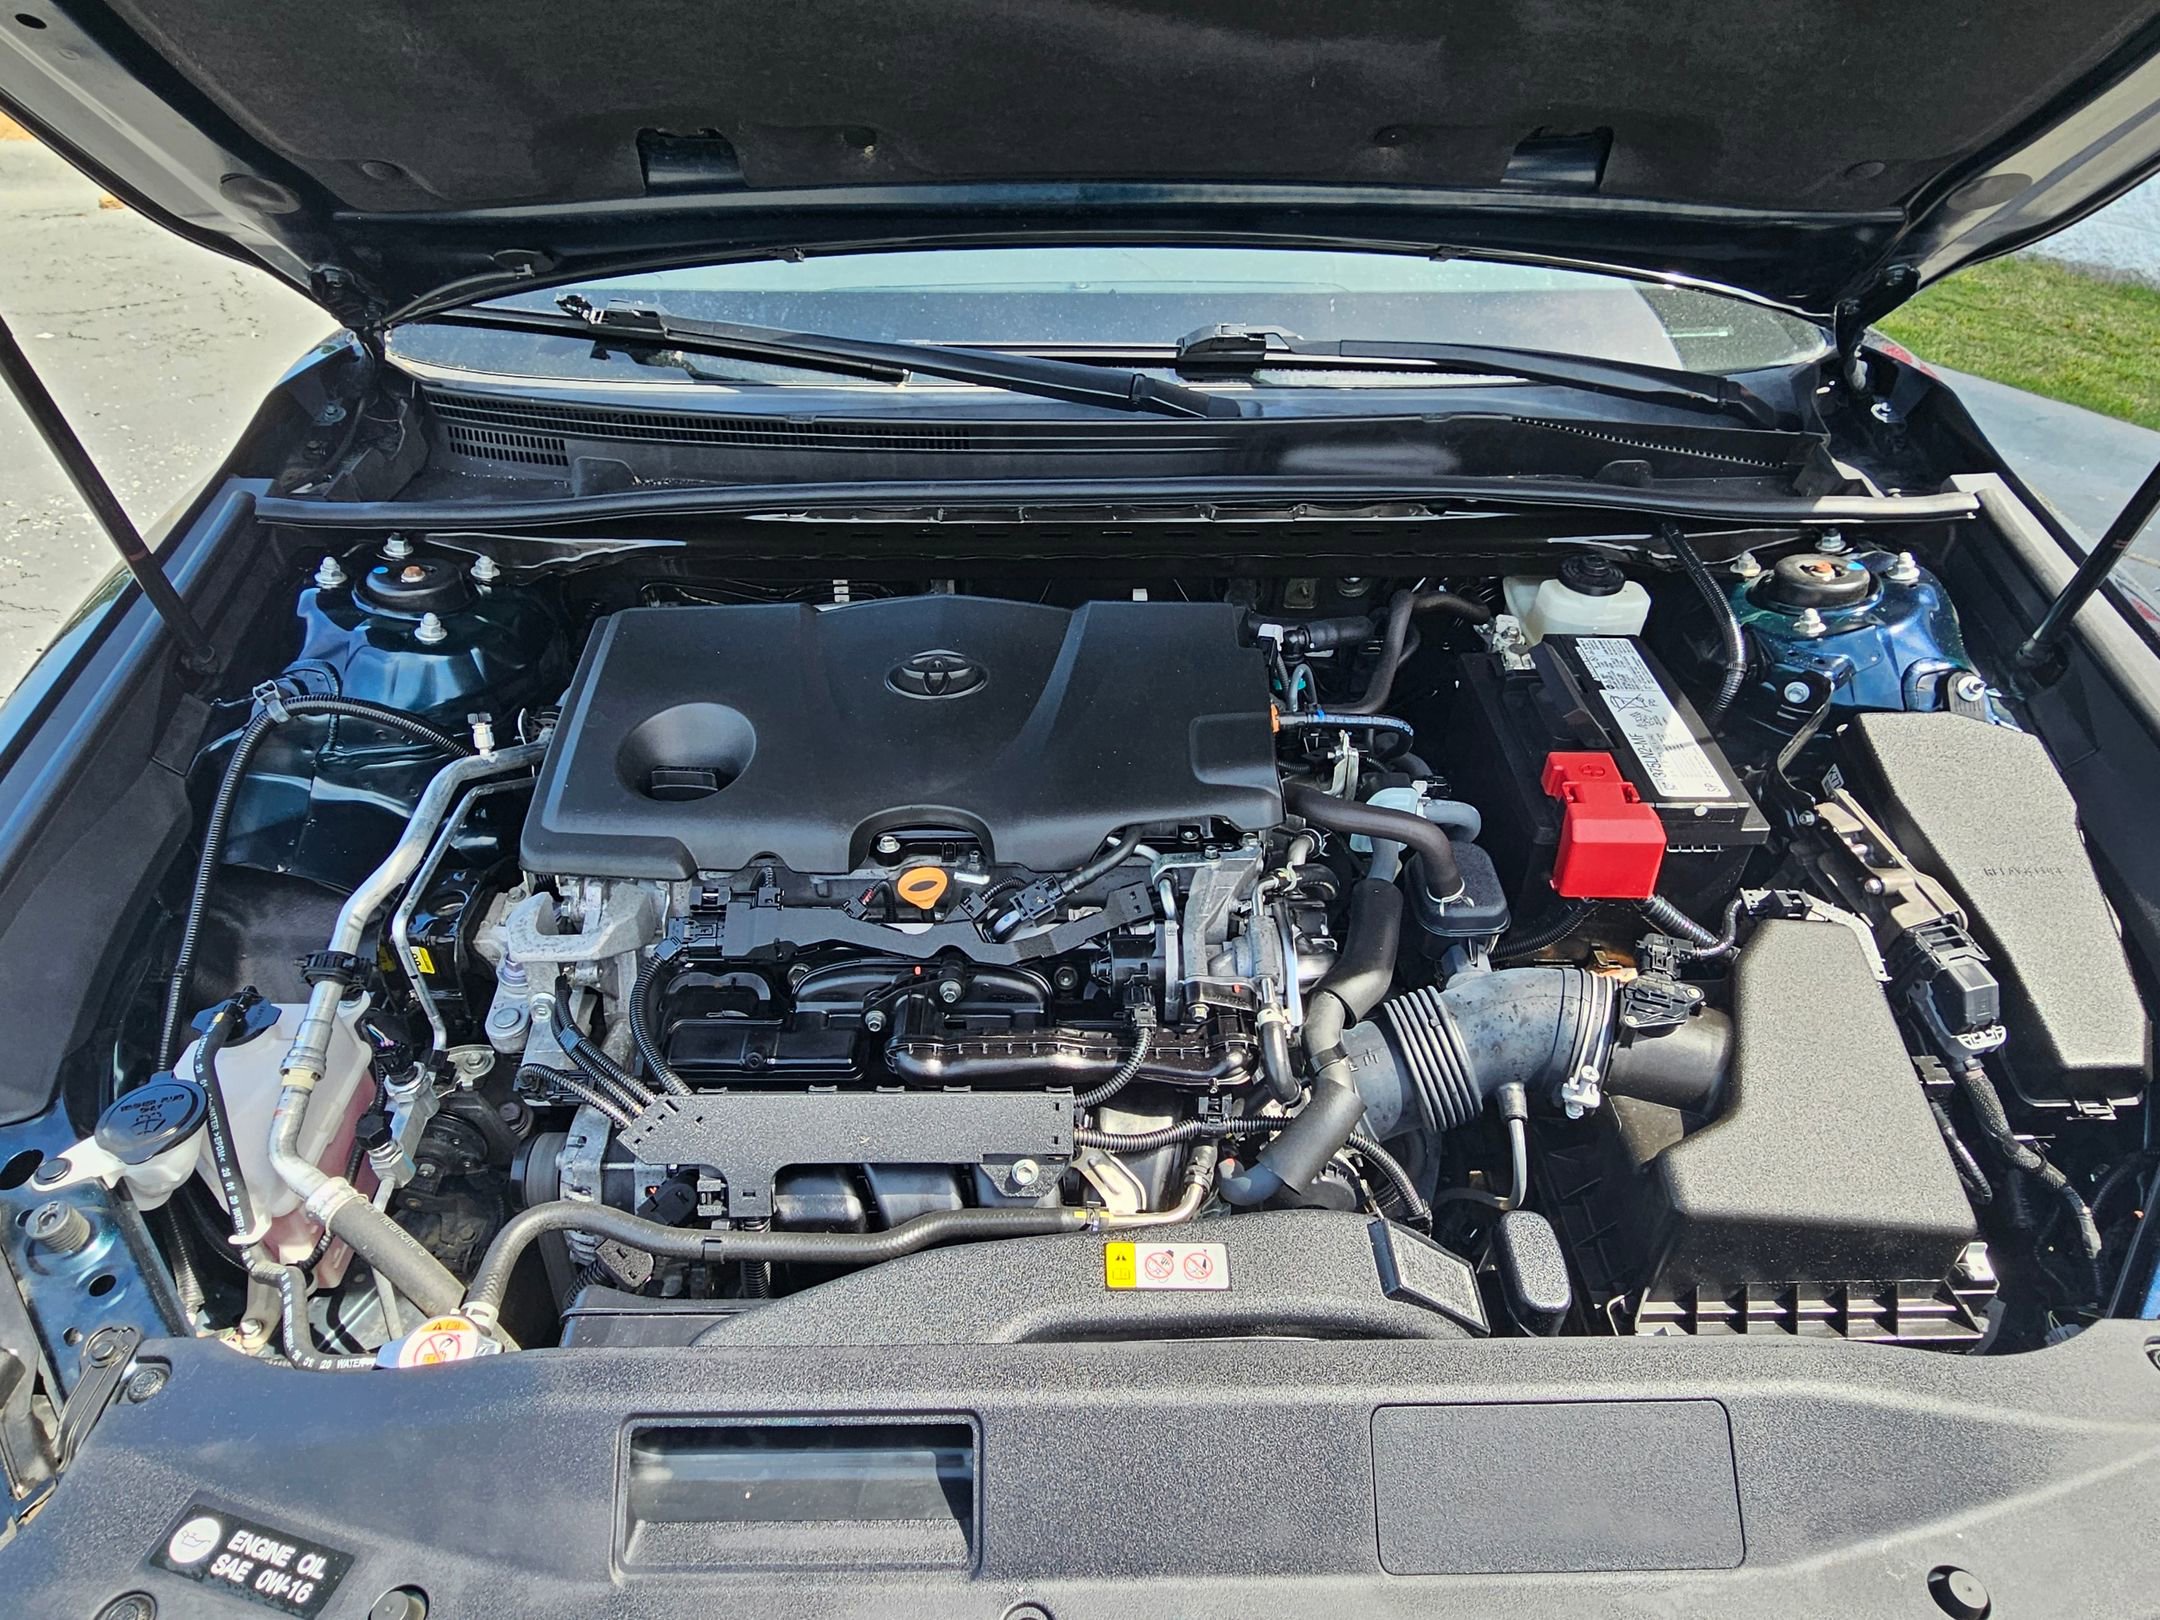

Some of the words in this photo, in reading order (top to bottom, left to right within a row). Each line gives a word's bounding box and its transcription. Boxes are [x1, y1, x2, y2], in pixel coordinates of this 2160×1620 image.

[208, 1105, 220, 1132] WATER
[210, 1553, 254, 1582] SAE
[254, 1568, 315, 1604] 0W-16
[227, 1529, 296, 1568] ENGINE
[297, 1553, 327, 1580] OIL
